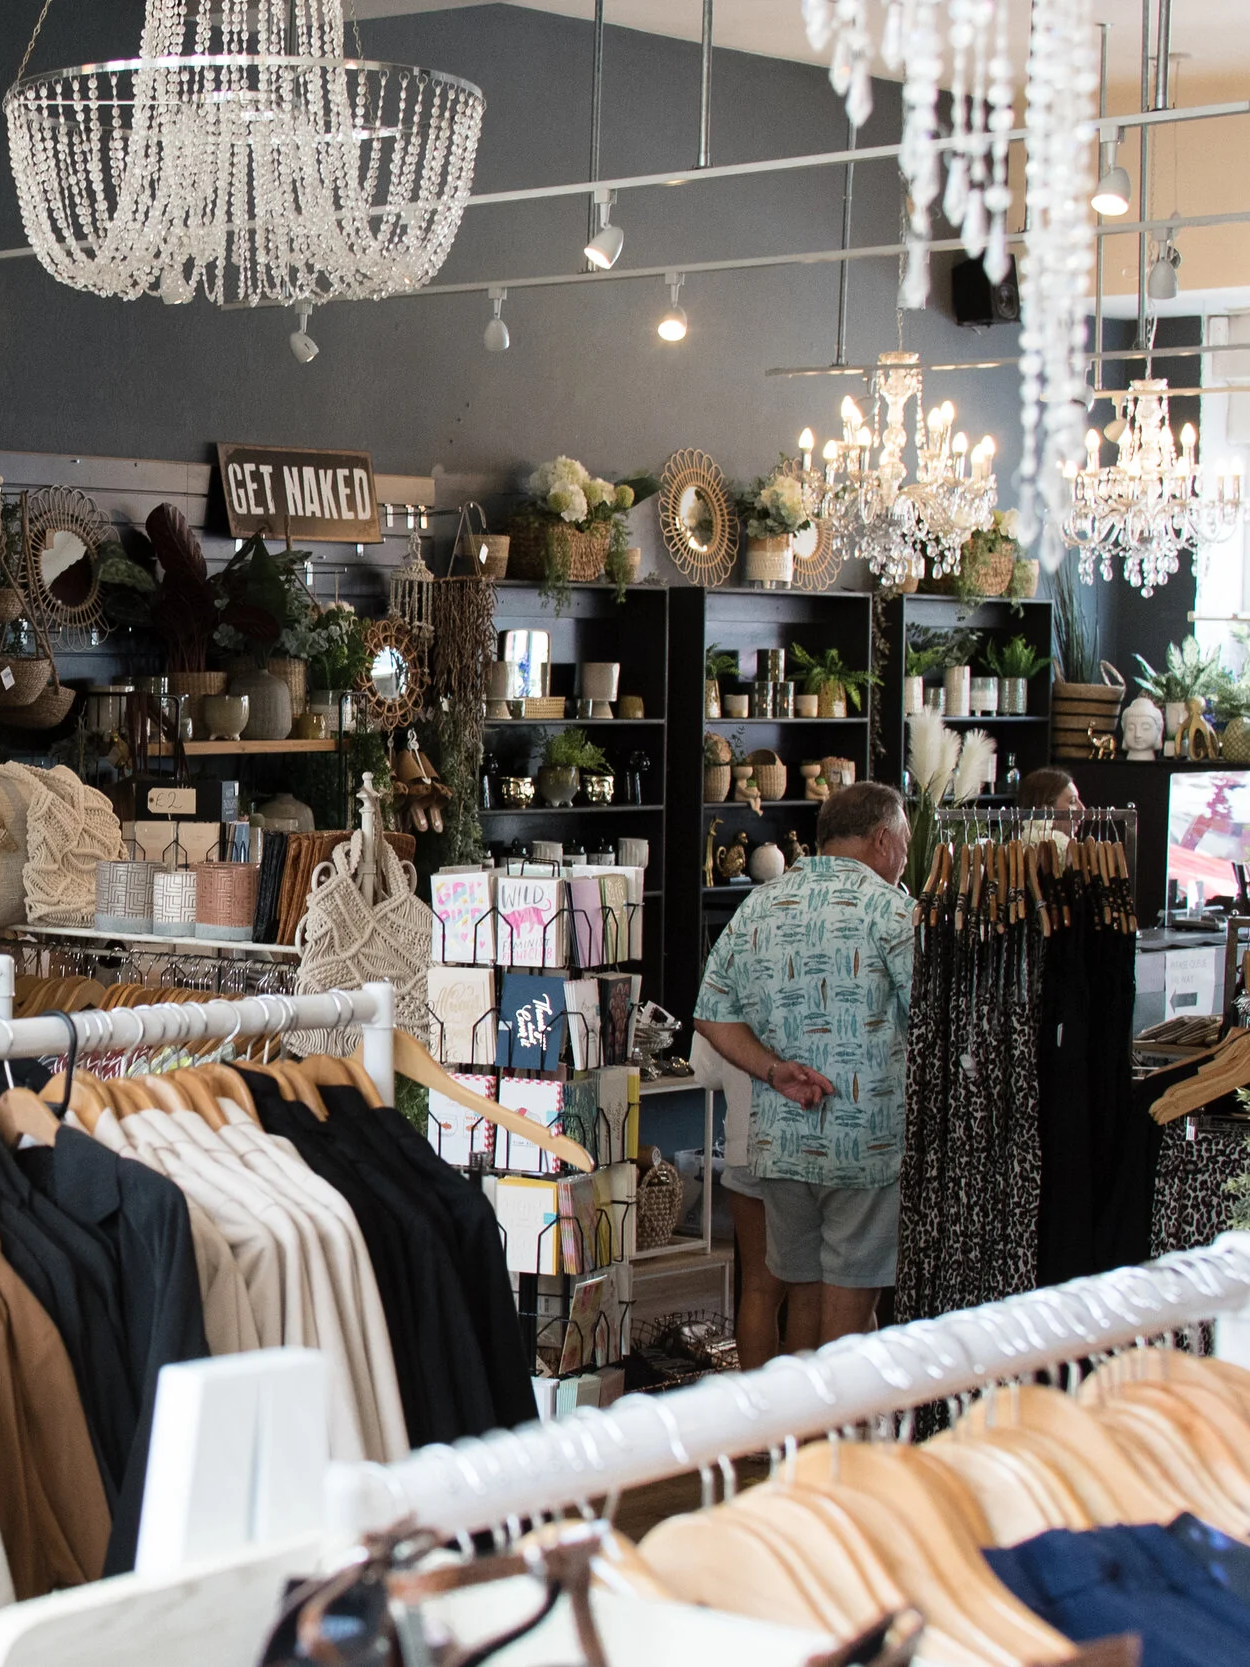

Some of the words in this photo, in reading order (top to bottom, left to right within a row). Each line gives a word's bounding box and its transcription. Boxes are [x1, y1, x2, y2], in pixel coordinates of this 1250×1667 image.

[227, 463, 276, 515] GET
[282, 465, 371, 521] NAKED
[501, 885, 545, 909] WILD
[502, 937, 550, 953] FMINIST
[502, 949, 527, 961] FIHT
